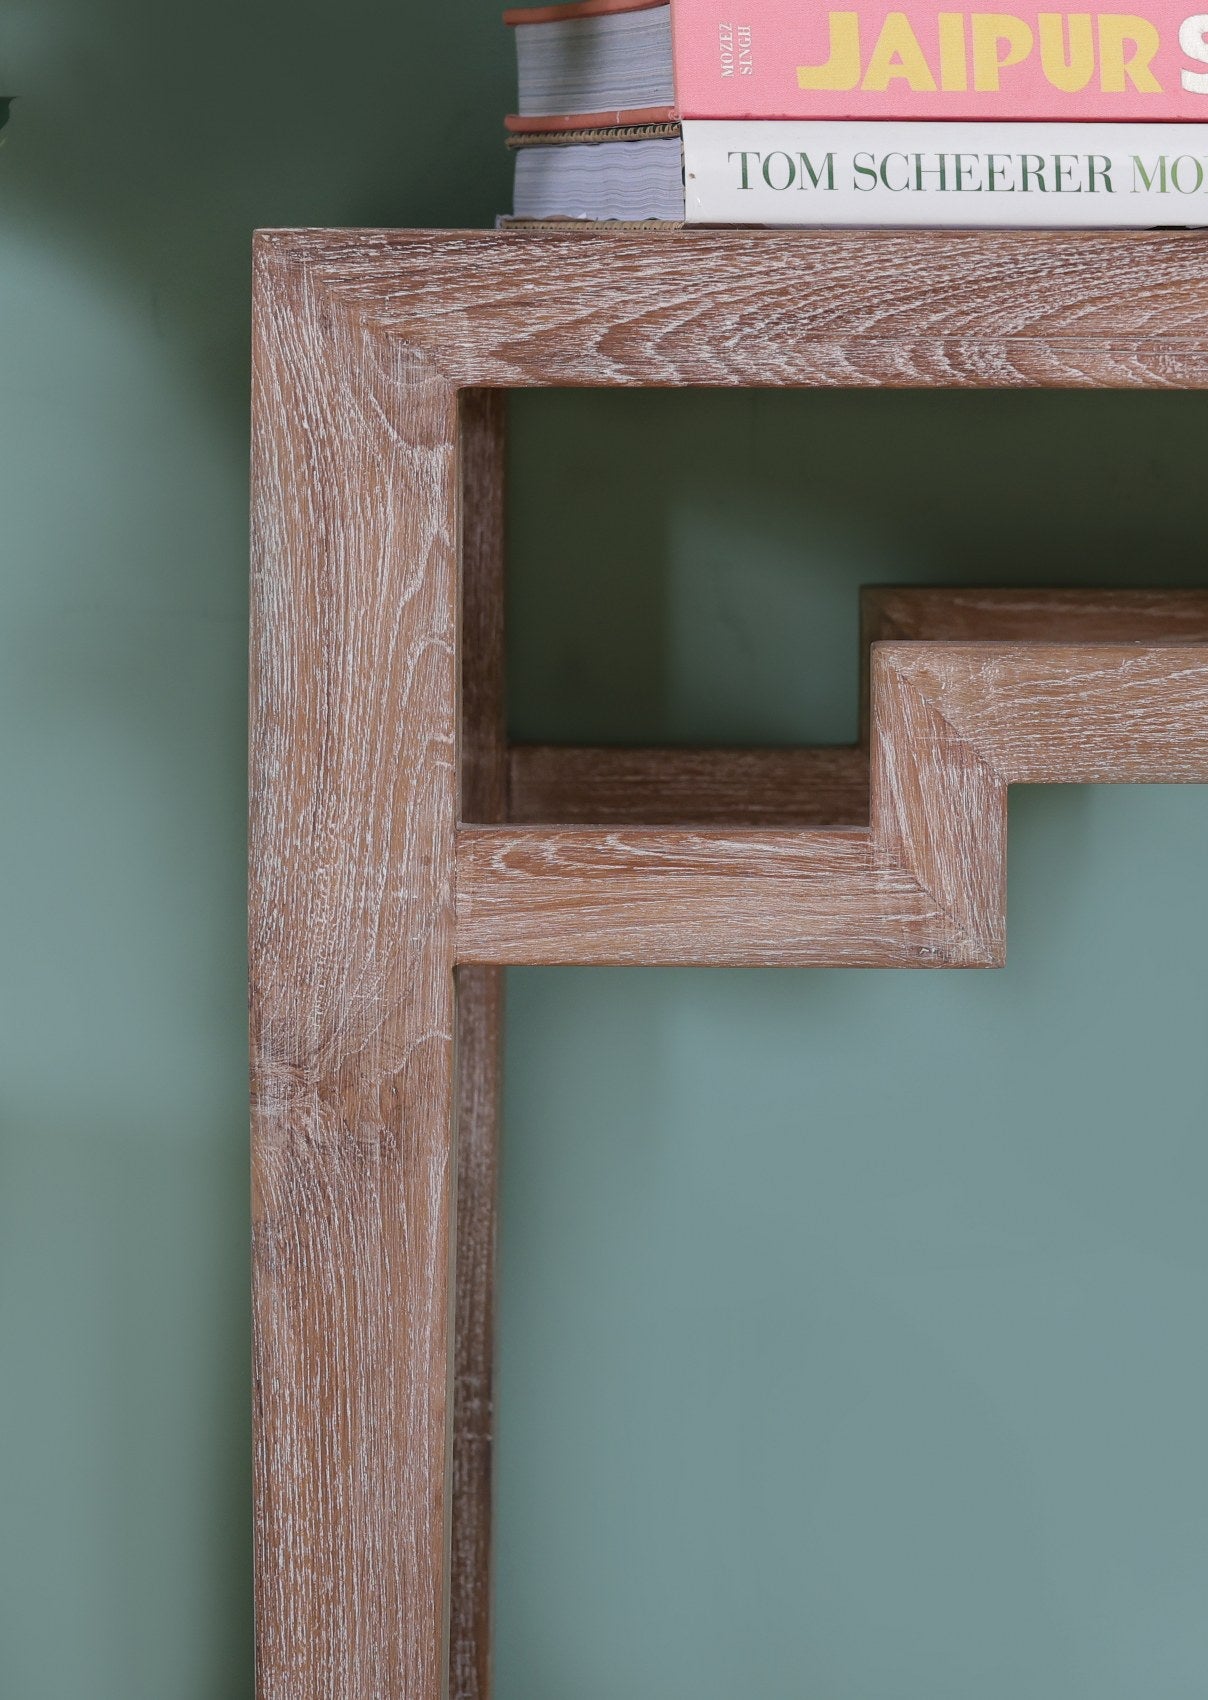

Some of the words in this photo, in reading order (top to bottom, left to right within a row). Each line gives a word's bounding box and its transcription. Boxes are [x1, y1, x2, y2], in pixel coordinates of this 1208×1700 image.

[719, 21, 735, 79] MOZEZ
[737, 25, 753, 76] SINGH
[796, 12, 1163, 93] JAIPUR
[727, 151, 838, 193] TOM
[852, 152, 1116, 195] SCHEERER
